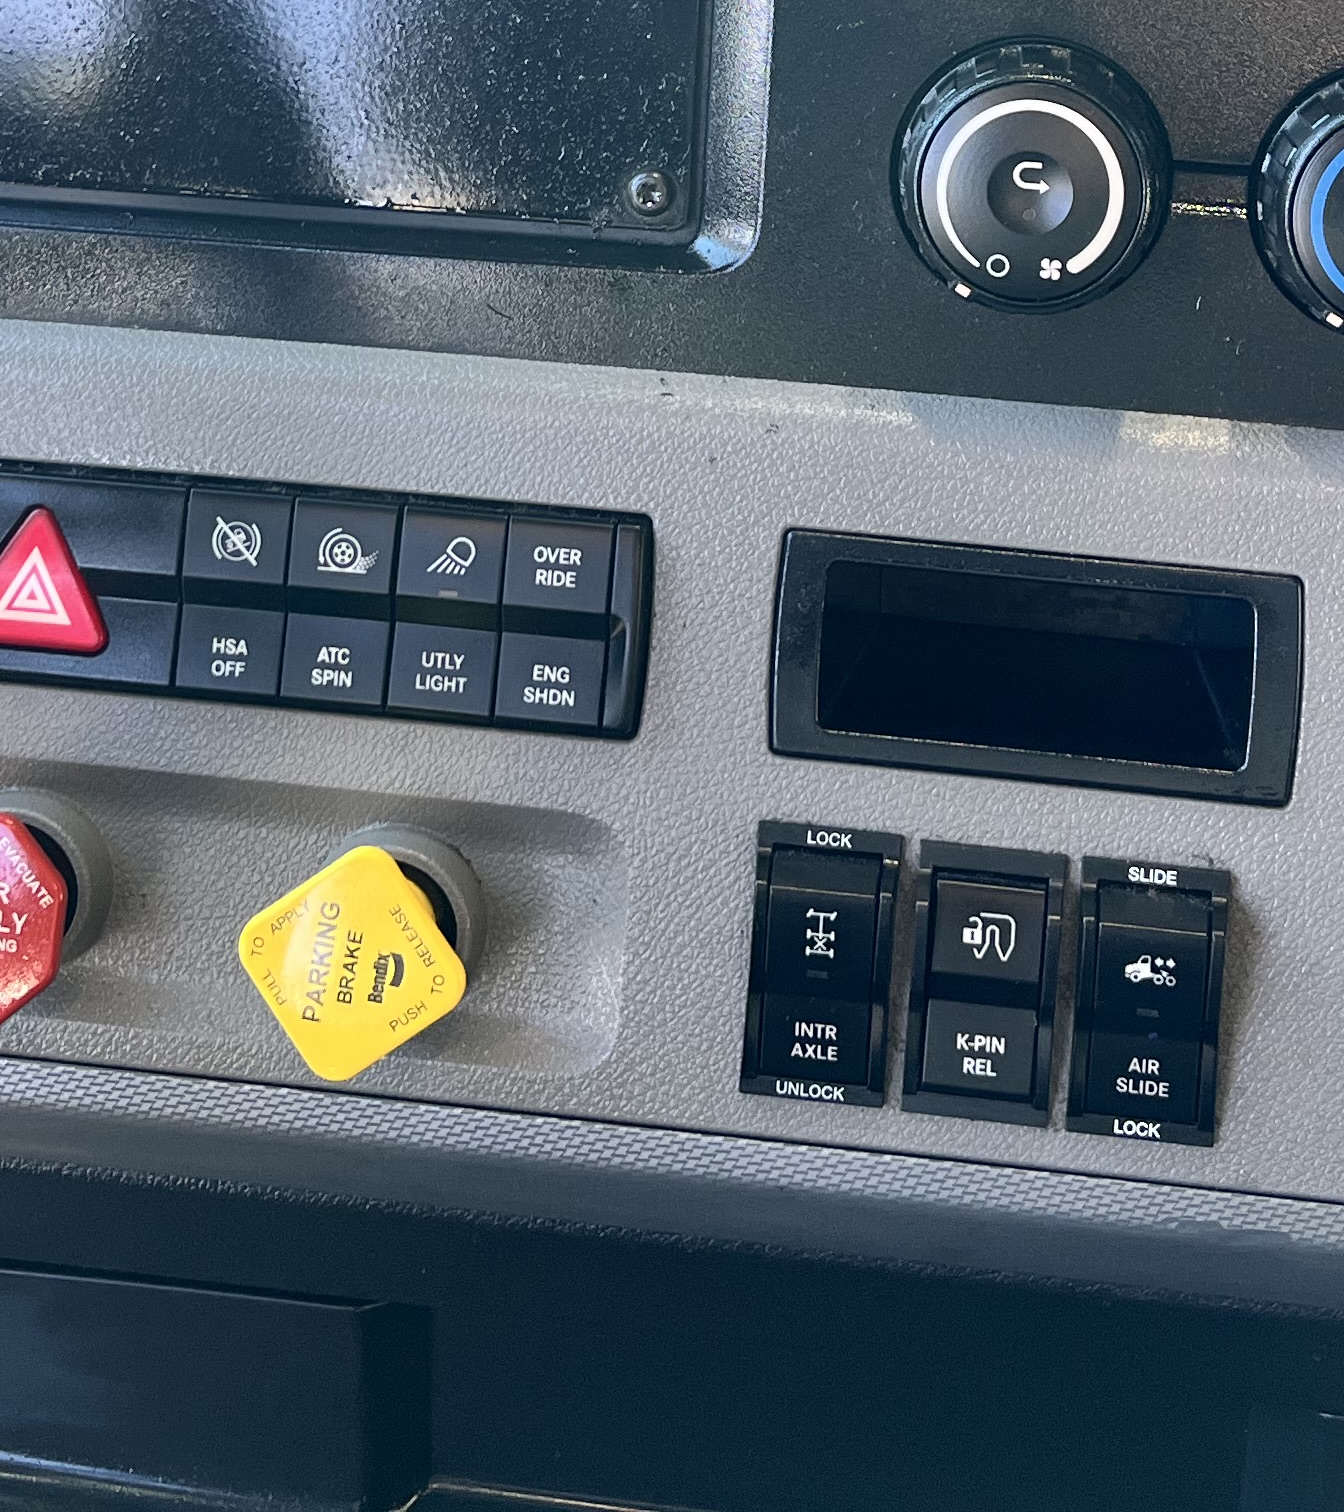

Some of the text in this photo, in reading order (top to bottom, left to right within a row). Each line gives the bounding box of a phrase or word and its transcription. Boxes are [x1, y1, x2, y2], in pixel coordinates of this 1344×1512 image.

[532, 545, 582, 567] OVER
[534, 568, 577, 589] RIDE
[211, 636, 249, 657] HSA
[316, 646, 351, 666] ATC
[210, 658, 246, 678] OFF
[421, 651, 466, 671] UTLY
[311, 668, 354, 688] SPIN
[414, 673, 468, 694] LIGHT
[531, 663, 571, 684] ENG
[522, 686, 575, 707] SHDN
[806, 830, 853, 849] LOCK
[1128, 866, 1179, 886] SLIDE
[251, 899, 311, 1007] PULL TO APPLY
[301, 900, 341, 1023] PARKING
[336, 930, 364, 1005] BRAKE
[367, 951, 391, 1004] Bendix
[388, 902, 445, 1032] PUSH TO RELEASE
[793, 1021, 838, 1041] INTR
[790, 1041, 839, 1062] AXLE
[955, 1033, 1006, 1056] K-PIN
[962, 1057, 997, 1077] REL
[1127, 1057, 1160, 1076] AIR
[775, 1080, 846, 1102] UNLOCK
[1115, 1077, 1170, 1099] SLIDE
[1113, 1118, 1161, 1139] LOCK
